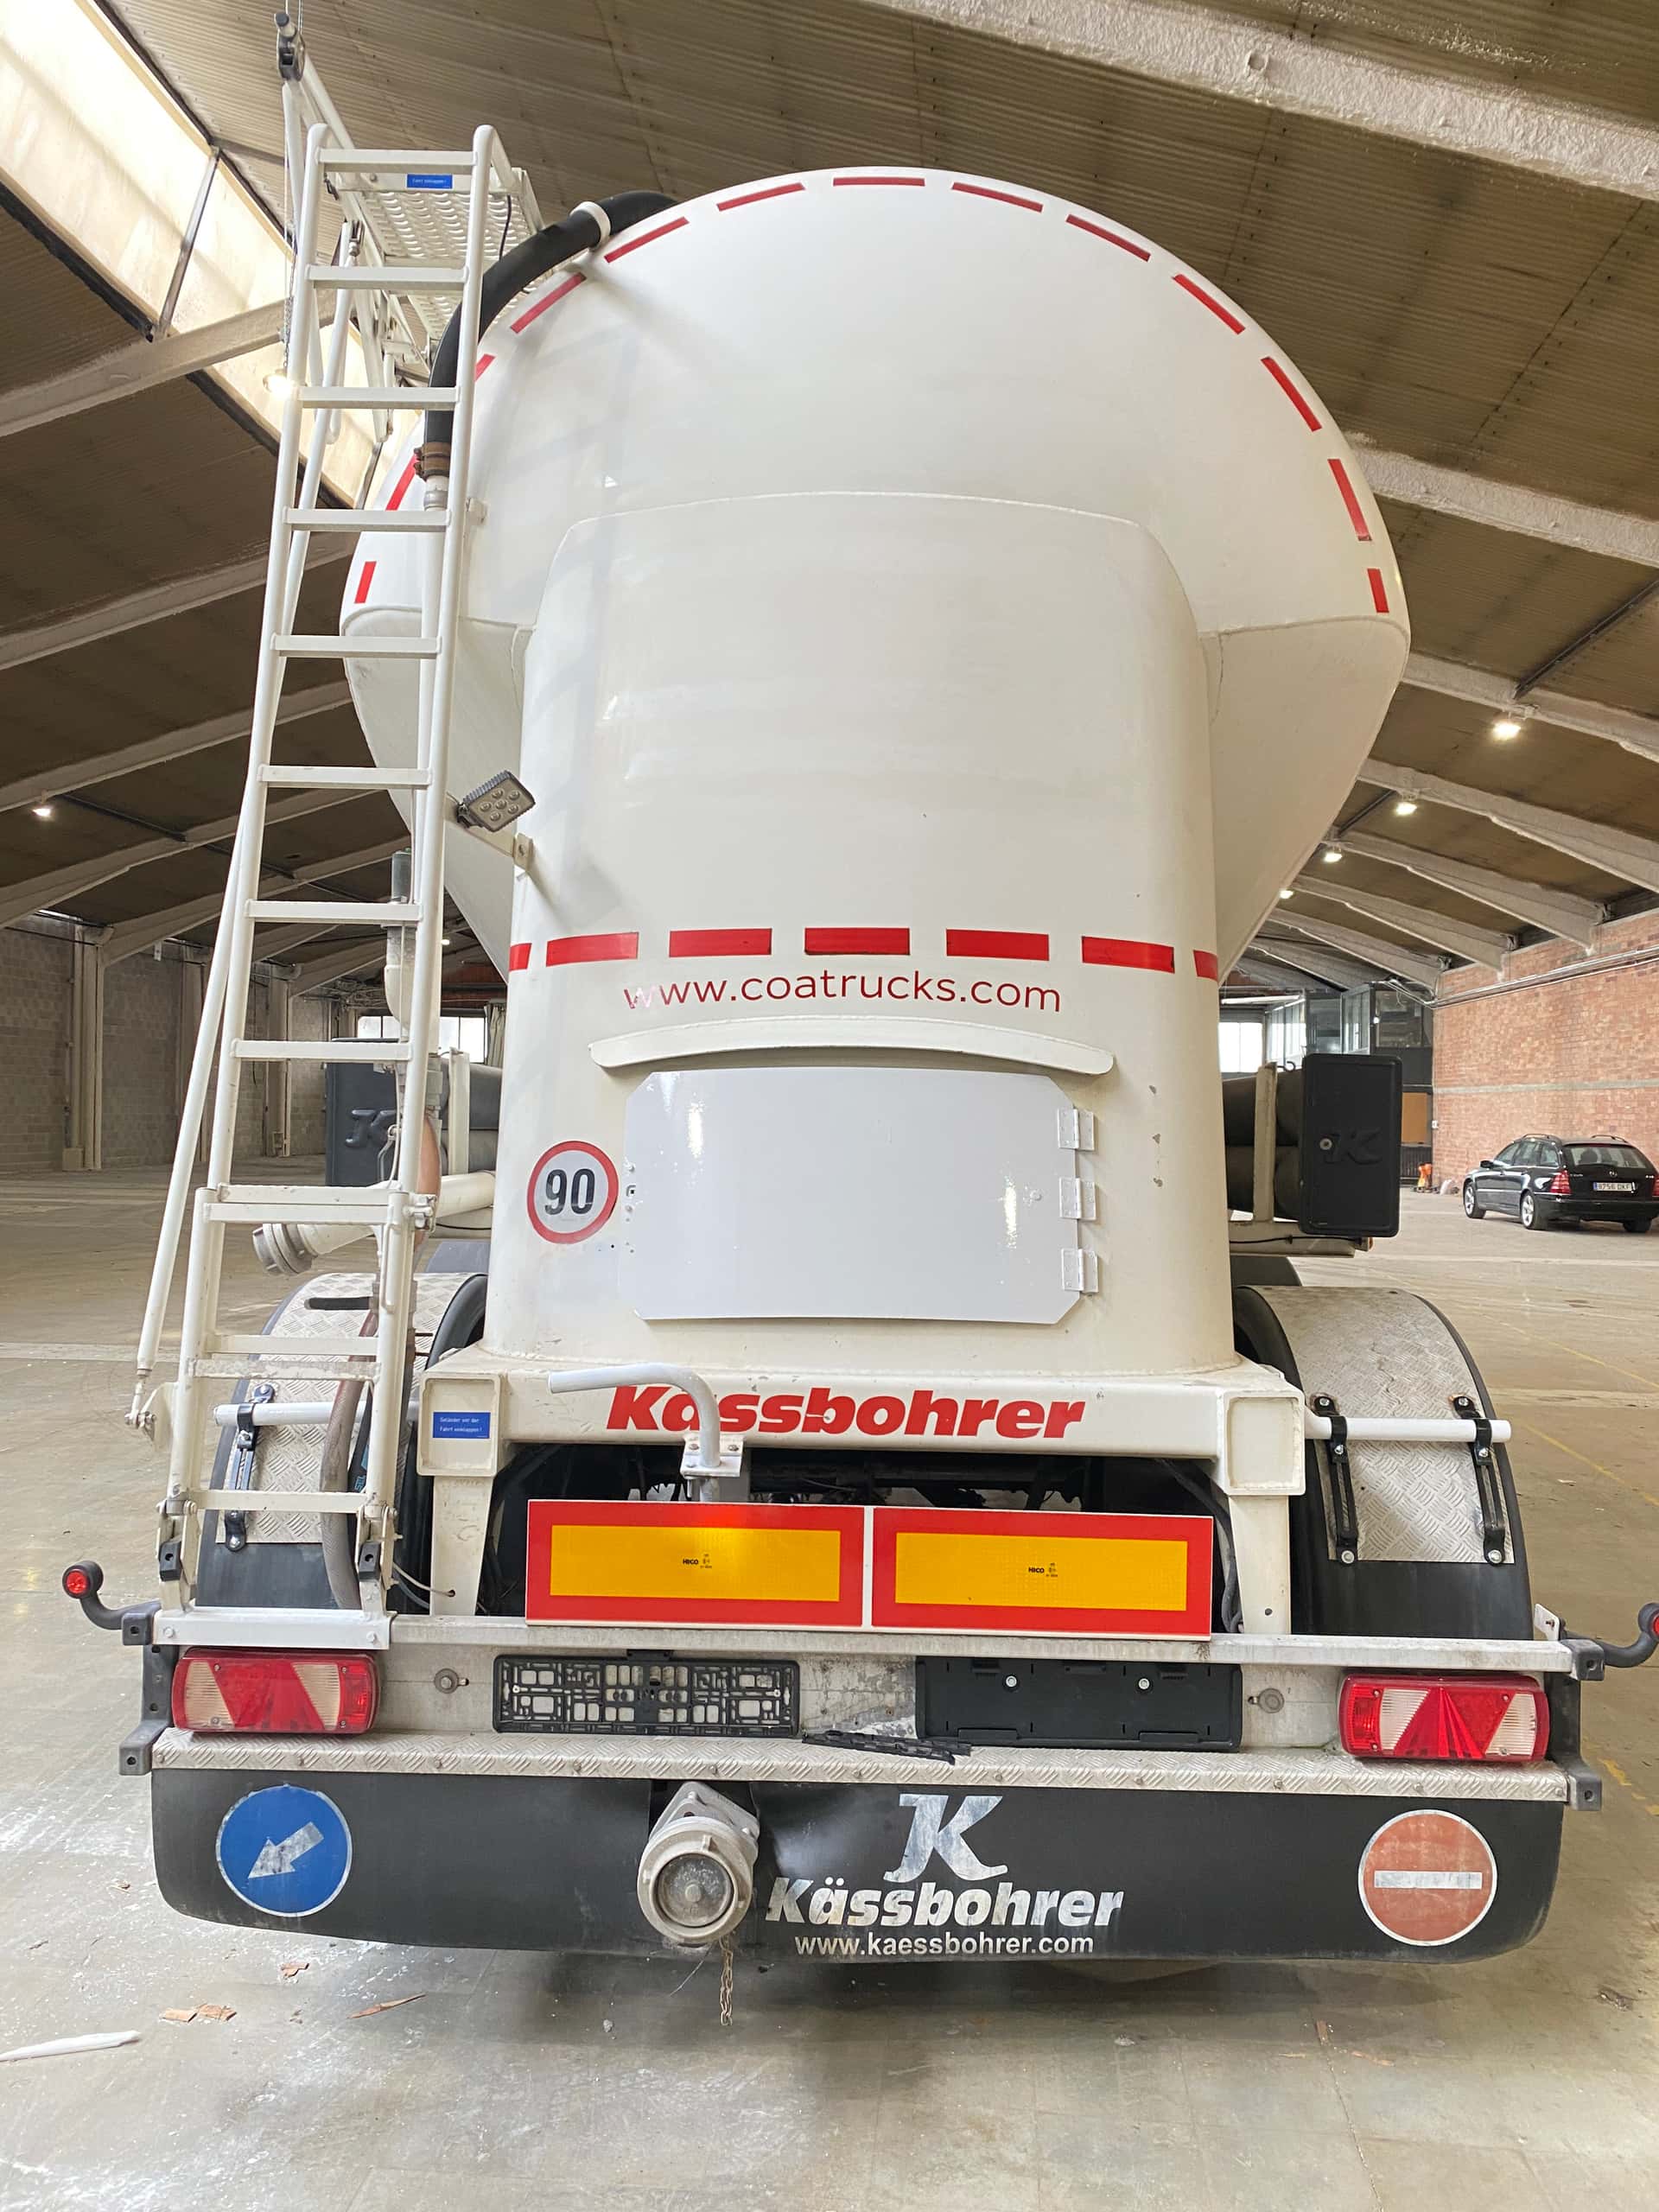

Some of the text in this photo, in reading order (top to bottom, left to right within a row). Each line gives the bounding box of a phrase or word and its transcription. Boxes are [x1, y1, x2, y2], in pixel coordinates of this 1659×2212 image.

[623, 969, 1061, 1012] www.coatrucks.com
[544, 1168, 595, 1215] 90
[765, 1876, 1124, 1927] Kässbohrer
[795, 1932, 1093, 1956] www.kaessbohrer.com
